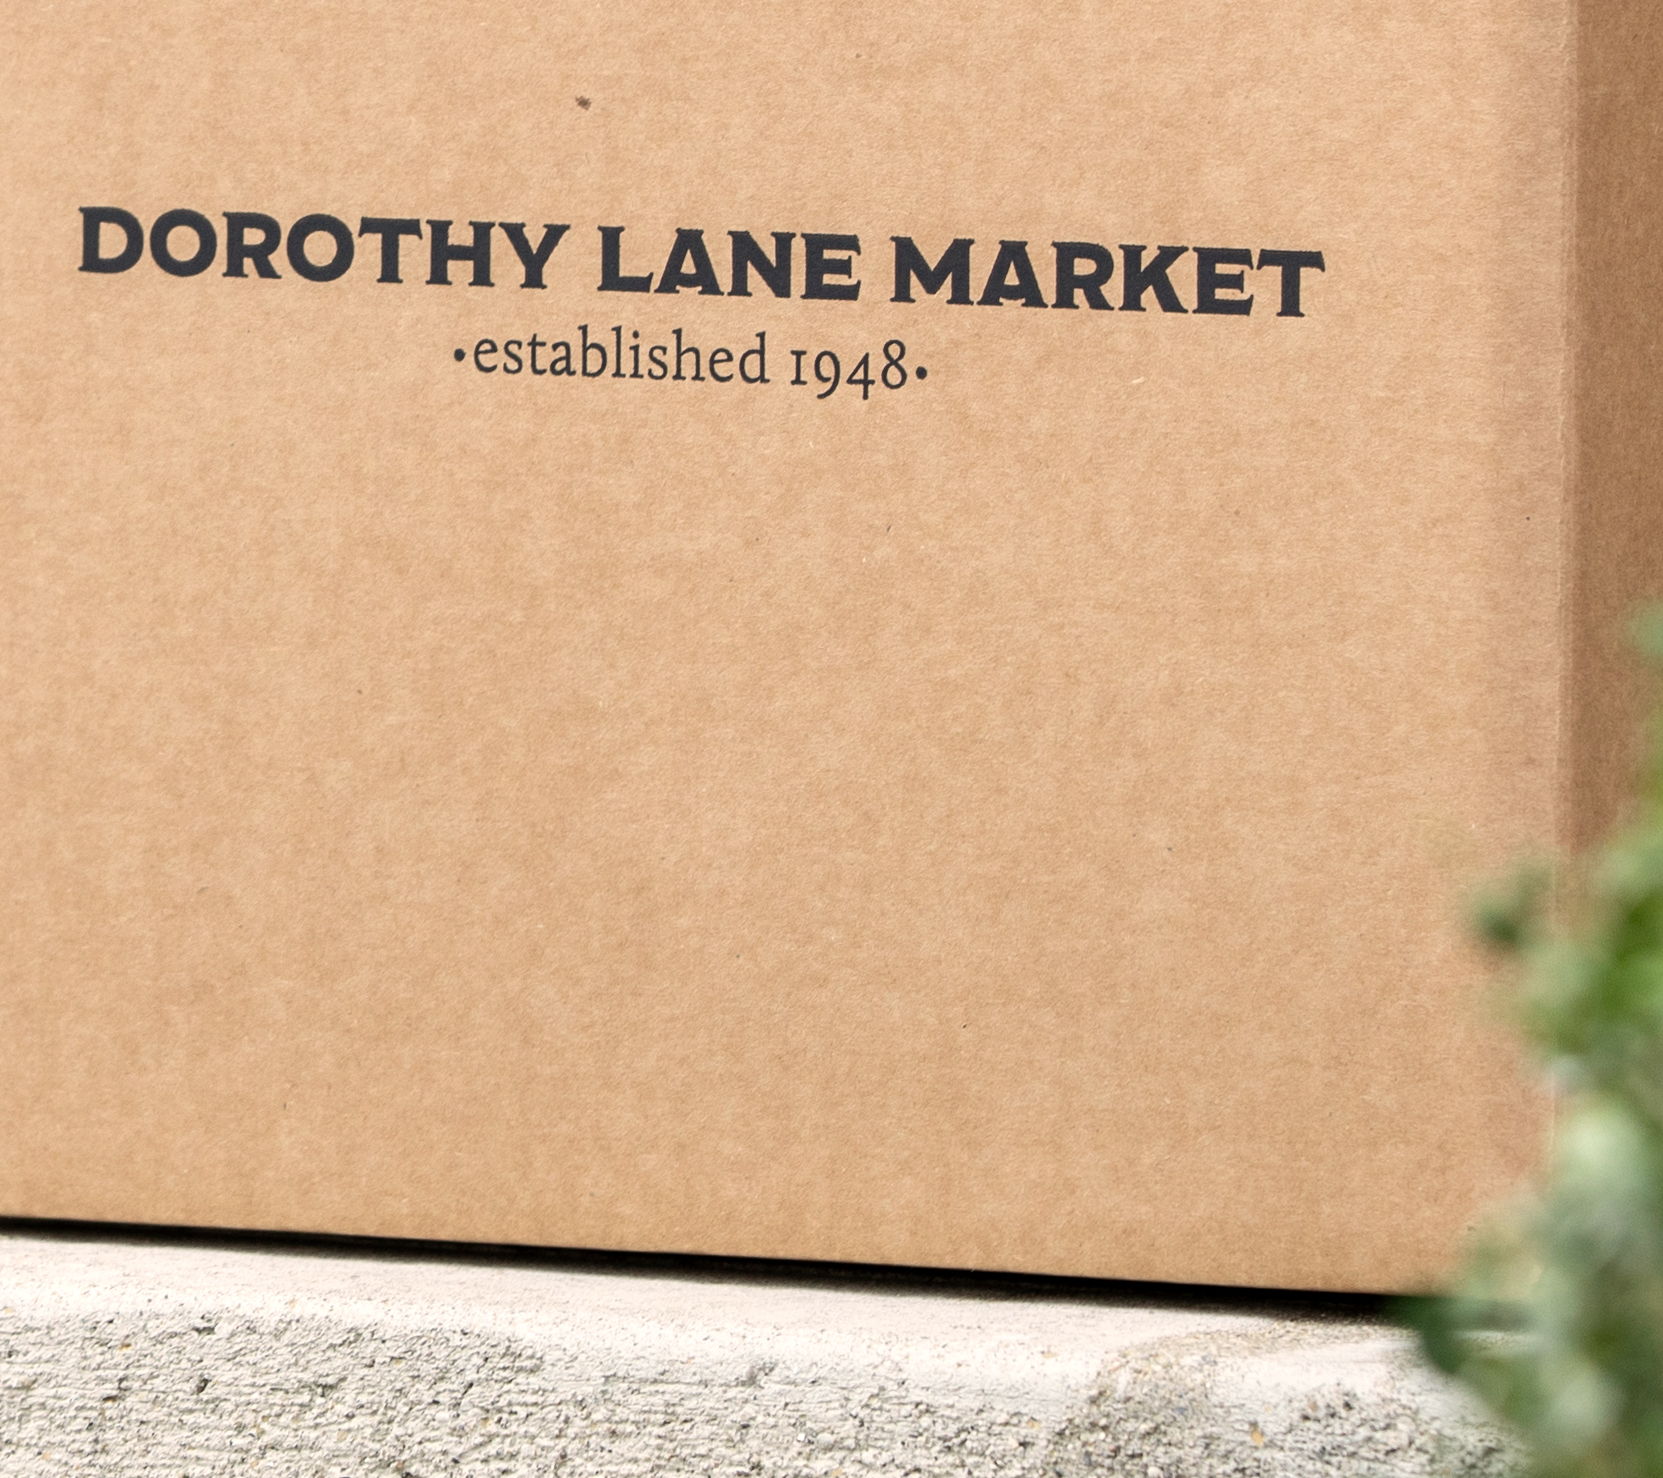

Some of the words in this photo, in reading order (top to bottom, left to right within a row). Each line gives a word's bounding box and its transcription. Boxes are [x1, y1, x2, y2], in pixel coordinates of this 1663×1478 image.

[78, 205, 572, 291] DOROTHY
[596, 225, 863, 303] LANE
[889, 235, 1327, 319] MARKET
